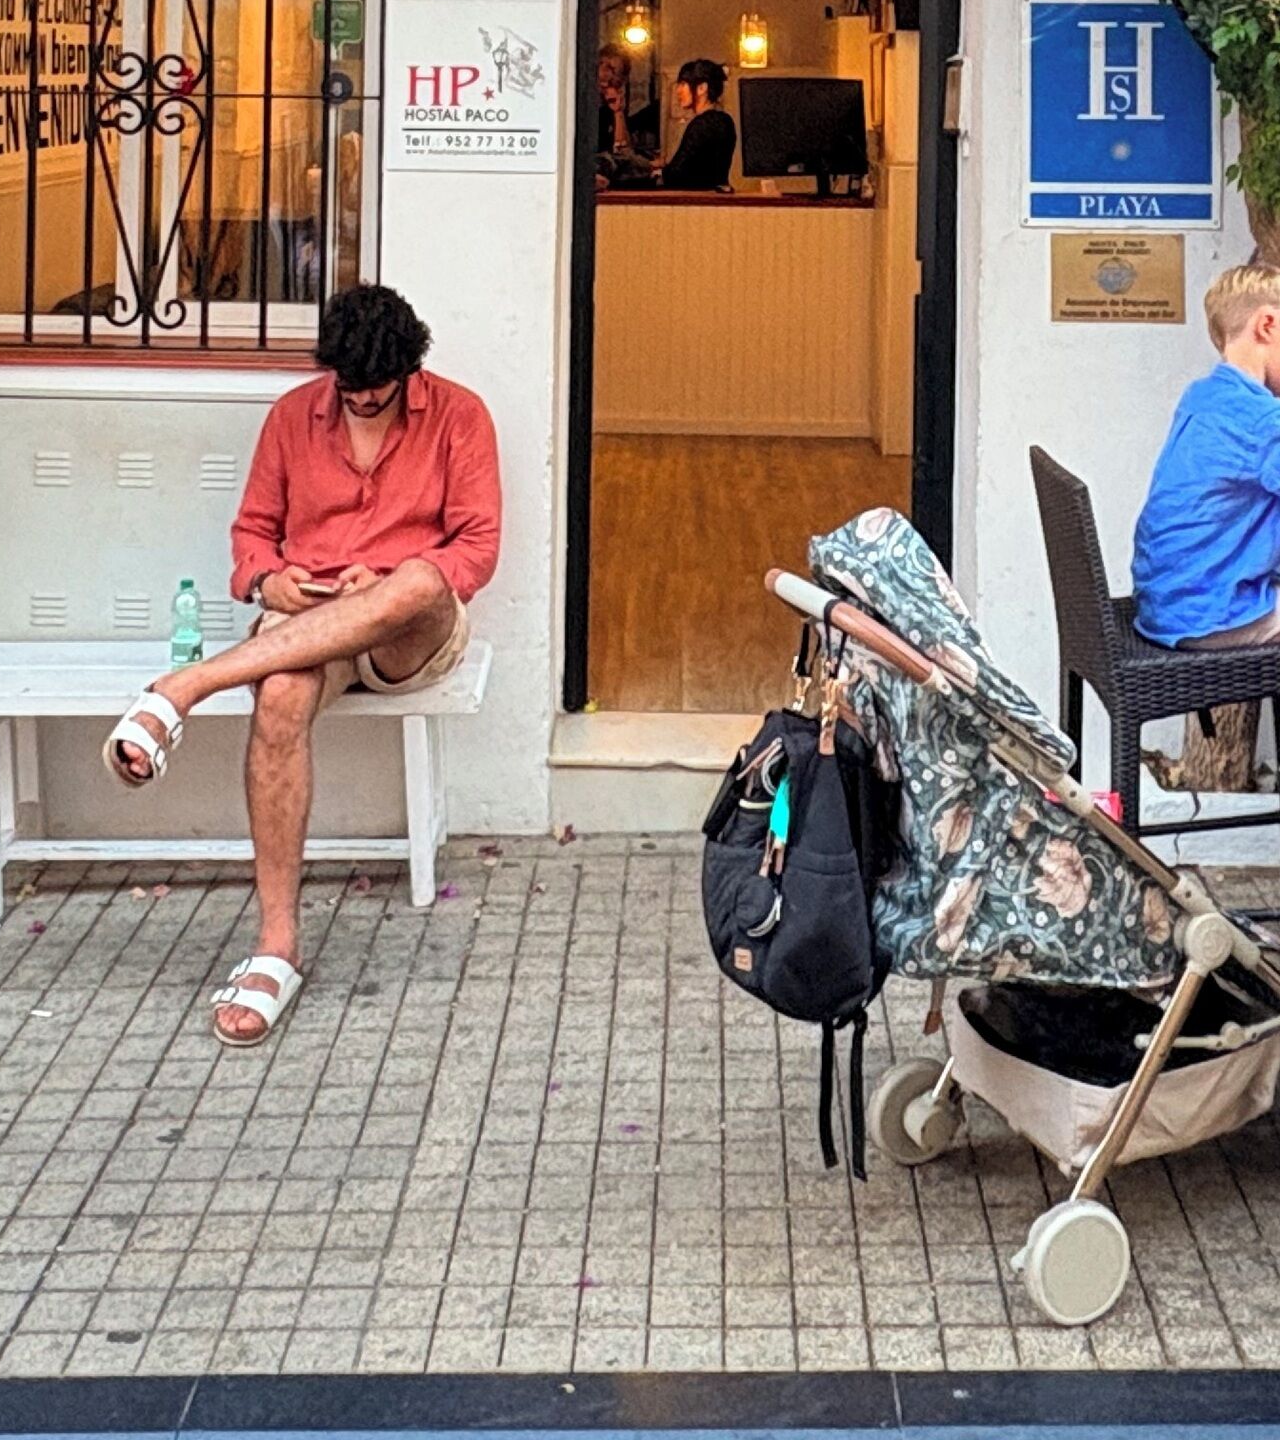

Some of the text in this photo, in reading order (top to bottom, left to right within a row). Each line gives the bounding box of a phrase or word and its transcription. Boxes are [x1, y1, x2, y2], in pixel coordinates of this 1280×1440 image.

[406, 65, 481, 107] HP
[404, 109, 510, 123] HOSTAL PACO
[445, 135, 471, 148] 952
[476, 136, 494, 148] 77
[500, 136, 516, 148] 12
[520, 136, 538, 149] 00
[1079, 195, 1163, 217] PLAYA
